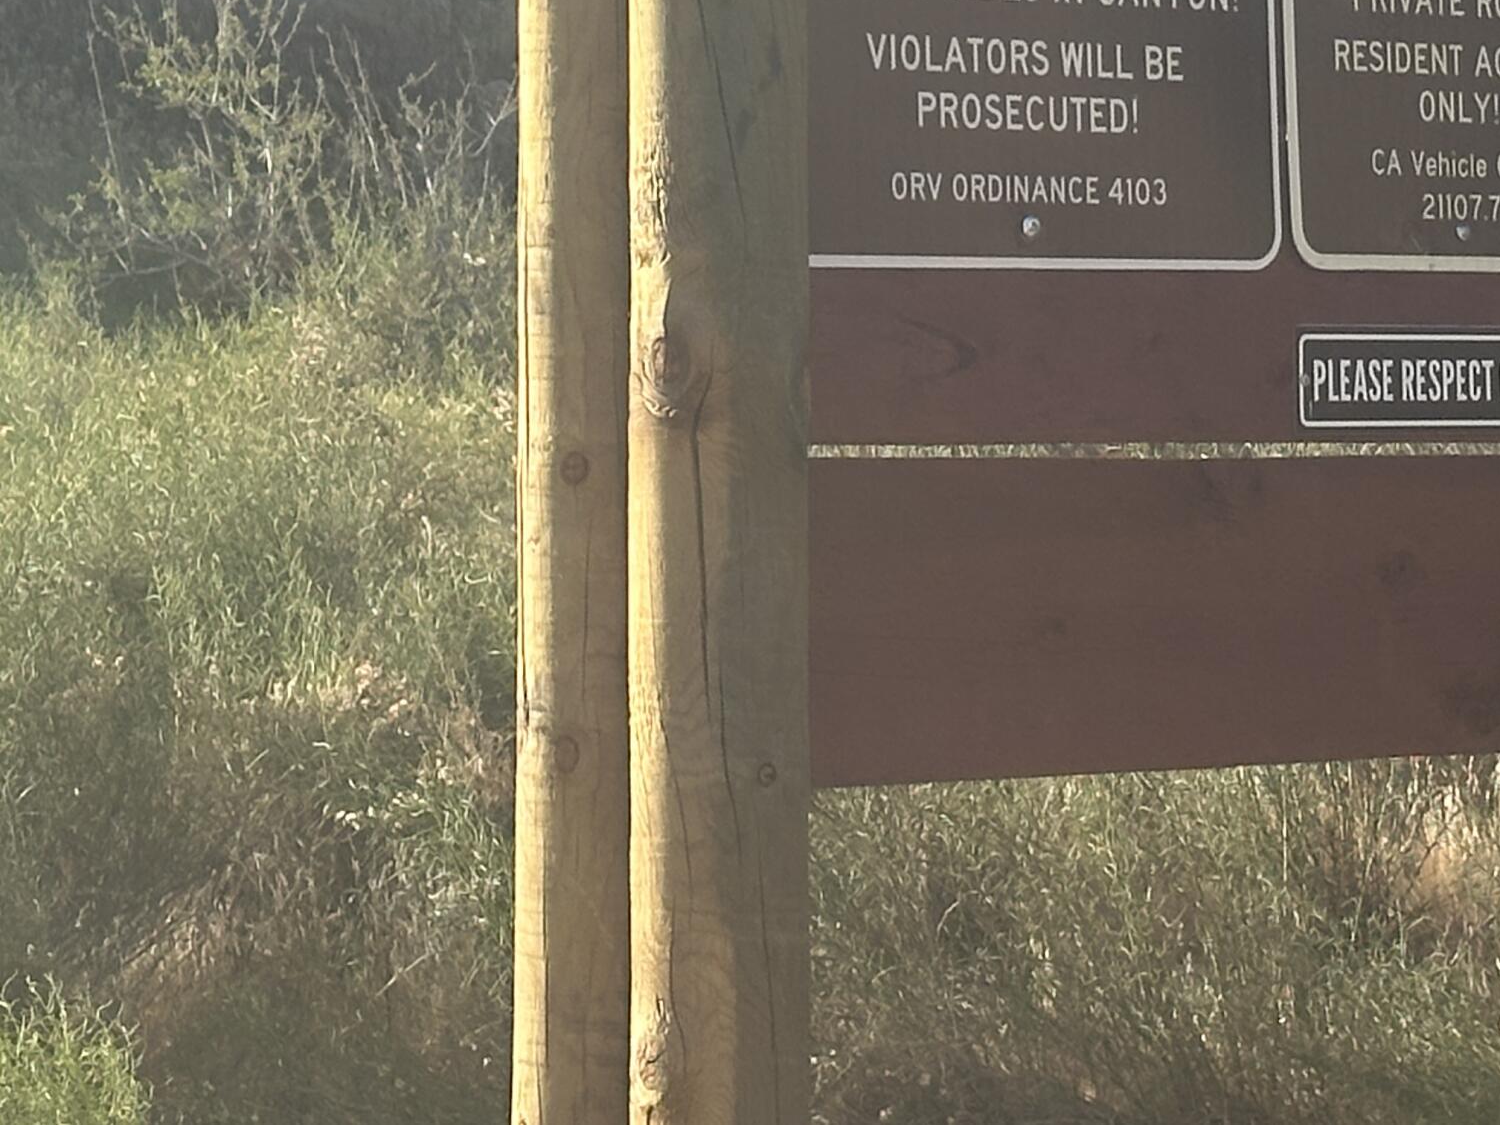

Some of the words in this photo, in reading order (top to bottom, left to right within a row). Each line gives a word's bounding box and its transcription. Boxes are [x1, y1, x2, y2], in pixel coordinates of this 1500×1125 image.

[866, 33, 1049, 76] VIOLATORS
[1061, 42, 1134, 80] WILL
[1144, 44, 1184, 81] BE
[1333, 39, 1463, 77] RESIDENT
[917, 92, 1139, 133] PROSECUTED!
[1419, 91, 1500, 125] ONLY!
[1371, 149, 1402, 177] CA
[1411, 151, 1486, 178] Vehicle
[891, 172, 943, 201] ORV
[952, 173, 1099, 204] ORDINANCE
[1108, 177, 1167, 206] 4103
[1422, 194, 1500, 222] 21107.7
[1313, 359, 1394, 402] PLEASE
[1402, 359, 1494, 402] RESPECT
